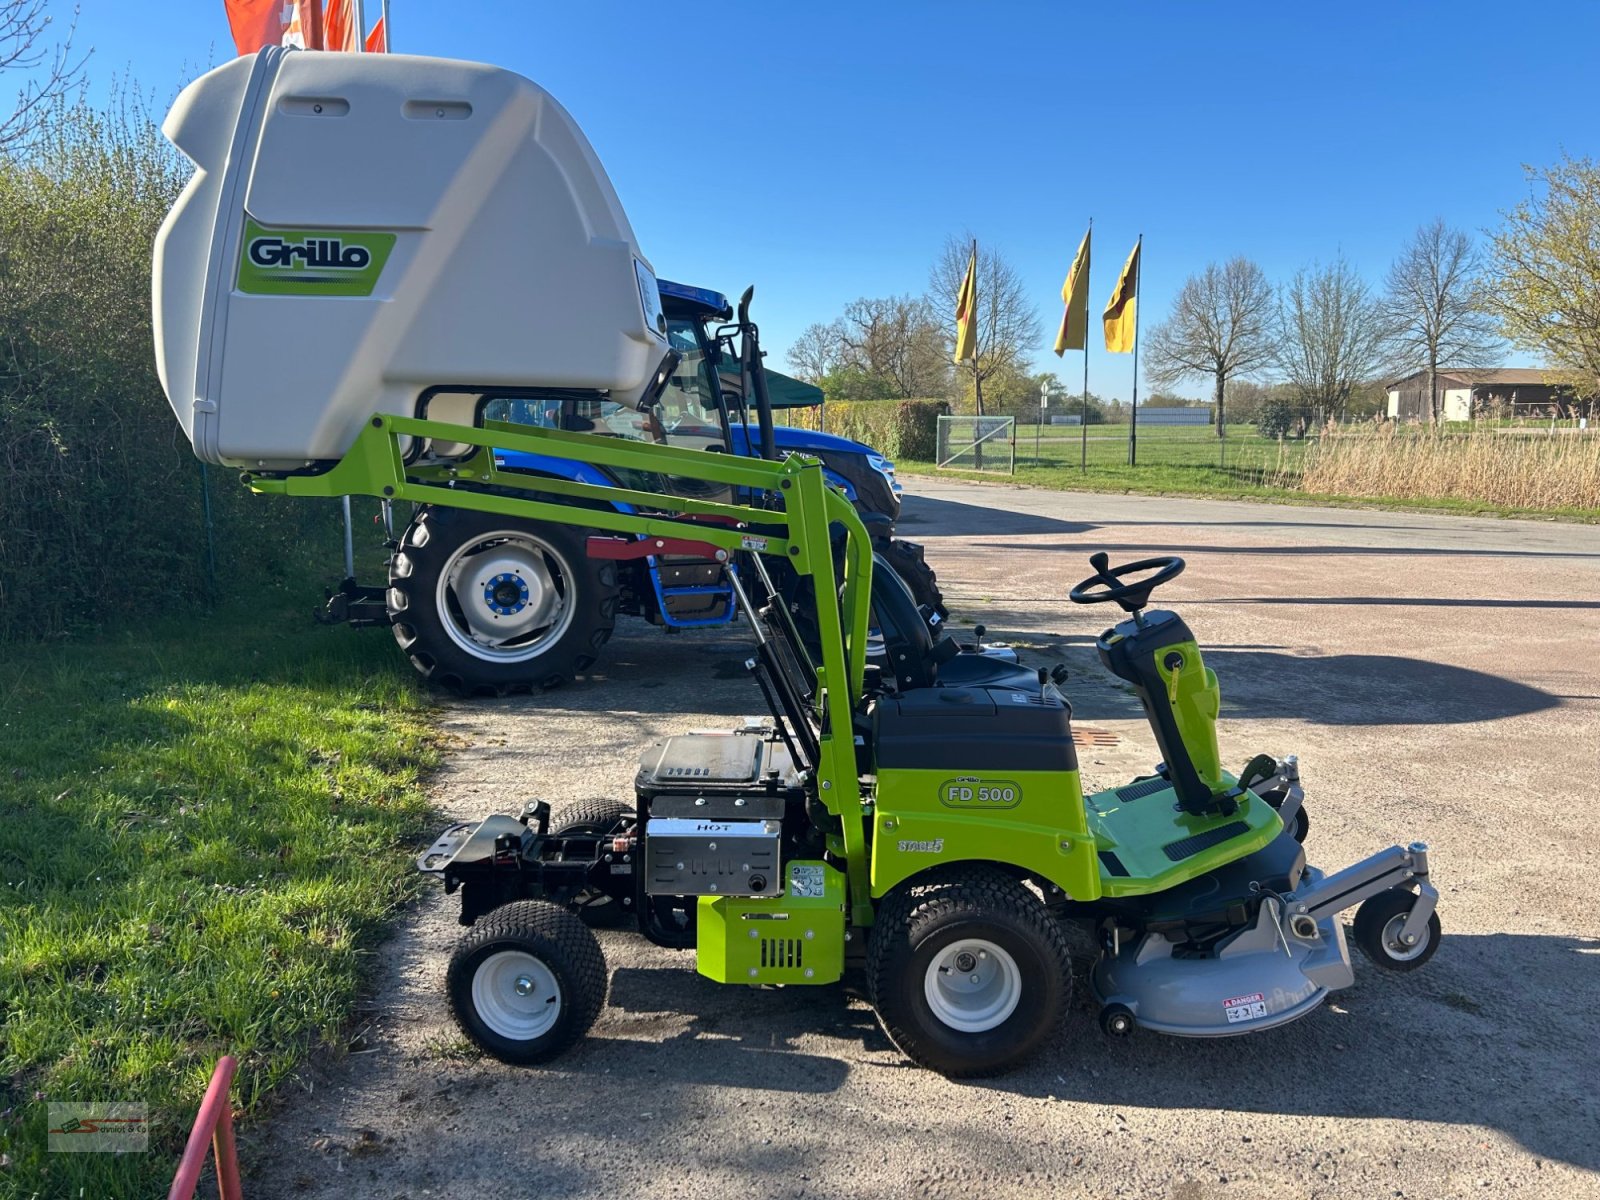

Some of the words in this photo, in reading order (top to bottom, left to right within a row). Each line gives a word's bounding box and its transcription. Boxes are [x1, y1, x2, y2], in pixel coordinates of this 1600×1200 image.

[249, 238, 370, 268] Grillo
[948, 787, 973, 801] FD
[978, 787, 1014, 802] 500
[1231, 994, 1261, 1006] DANGER
